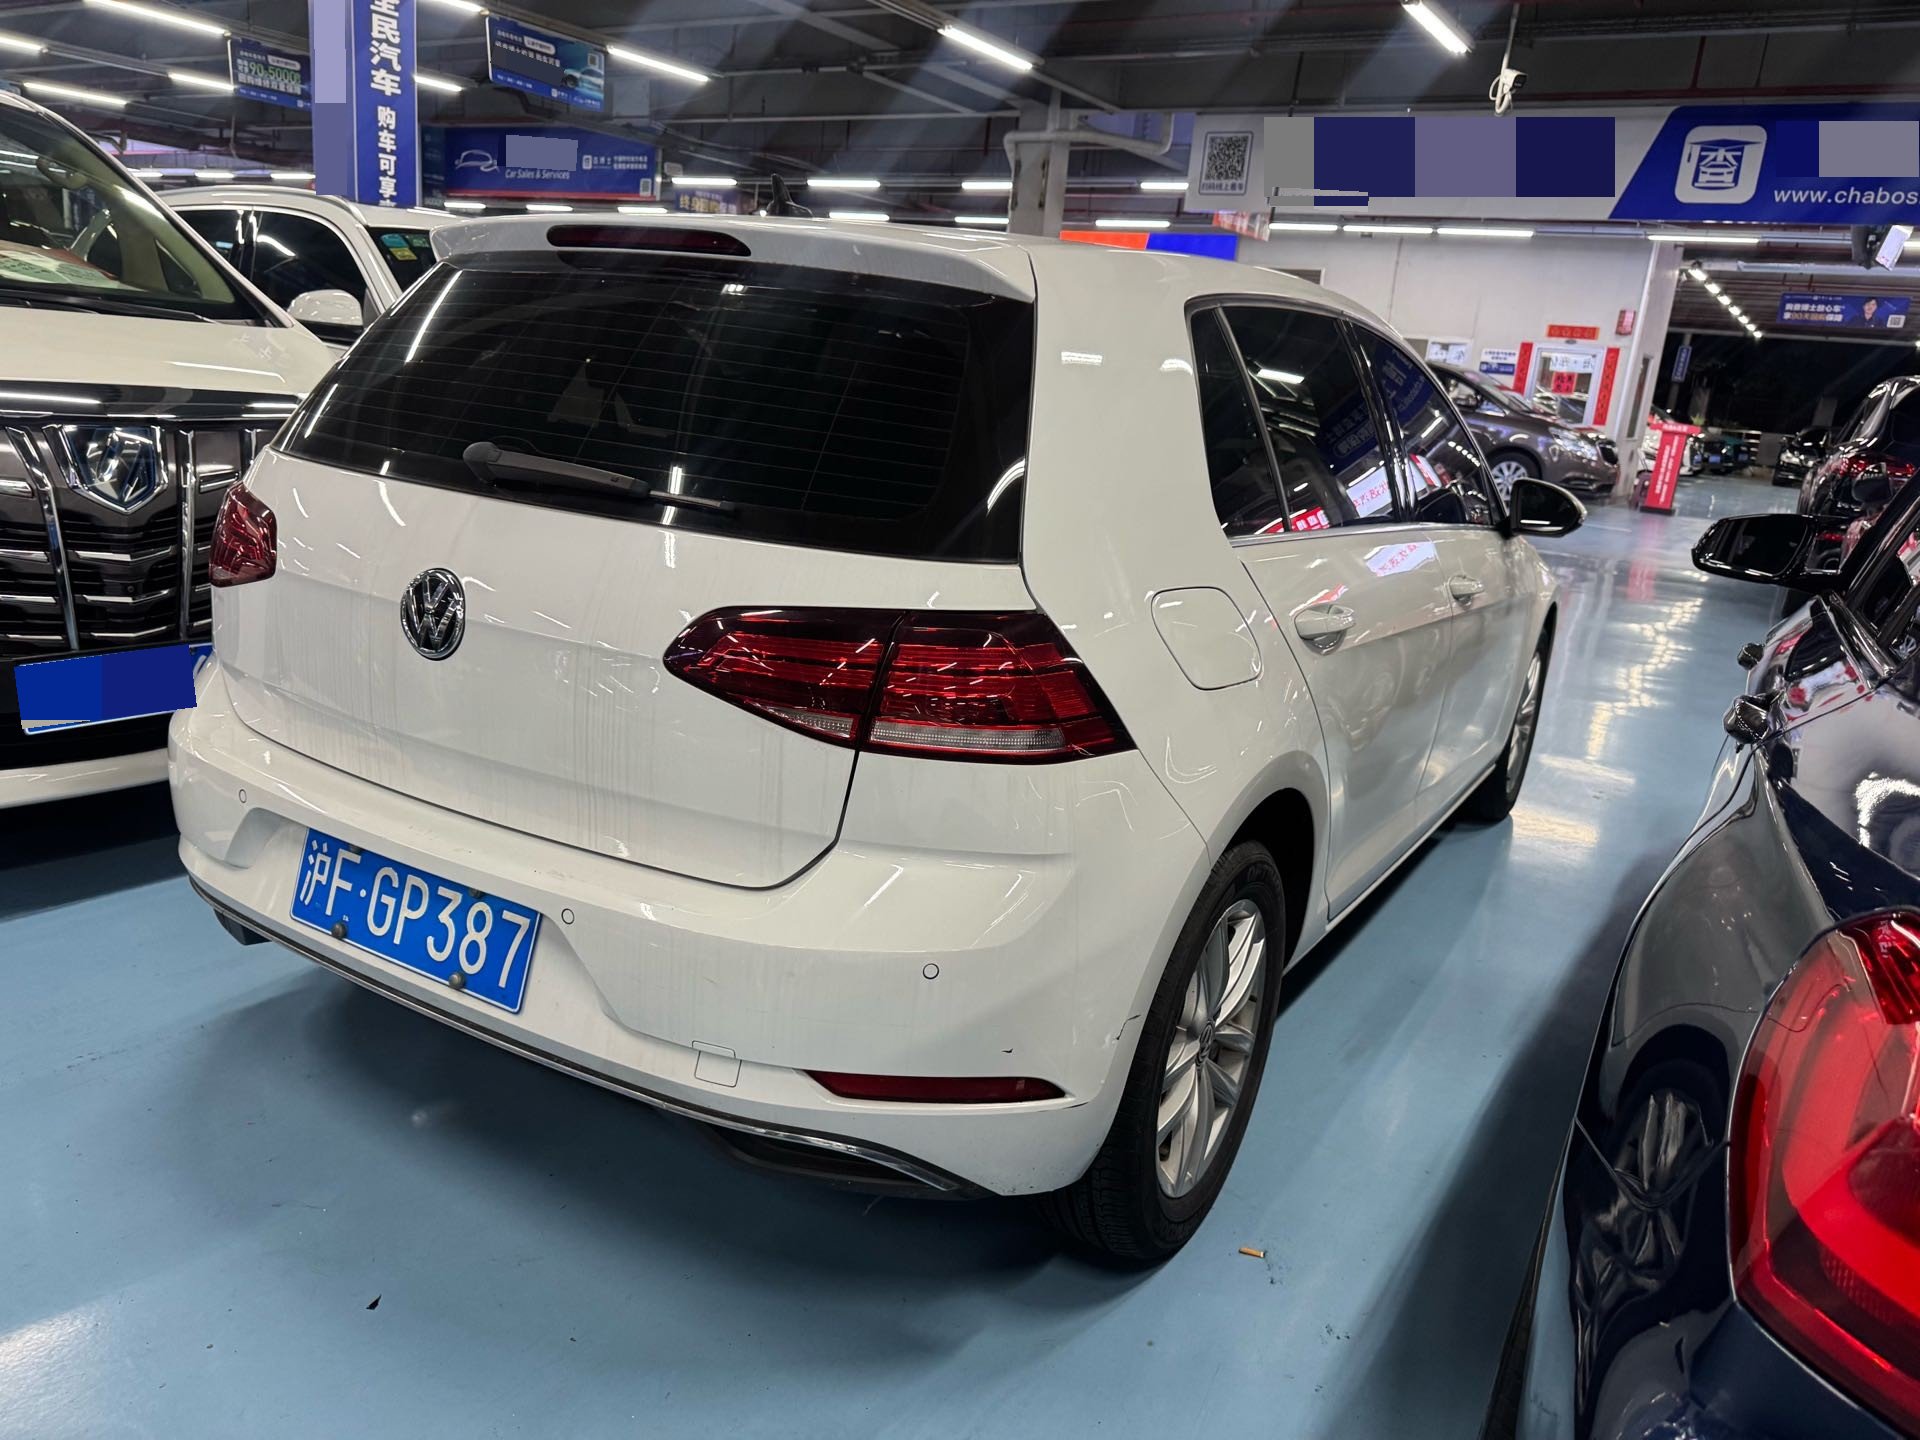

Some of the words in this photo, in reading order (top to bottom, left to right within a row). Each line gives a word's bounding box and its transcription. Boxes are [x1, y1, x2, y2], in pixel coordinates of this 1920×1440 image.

[505, 168, 516, 179] Car
[517, 169, 535, 179] Sales
[535, 170, 541, 179] &
[542, 170, 570, 180] Services
[1774, 186, 1920, 206] www.chabos
